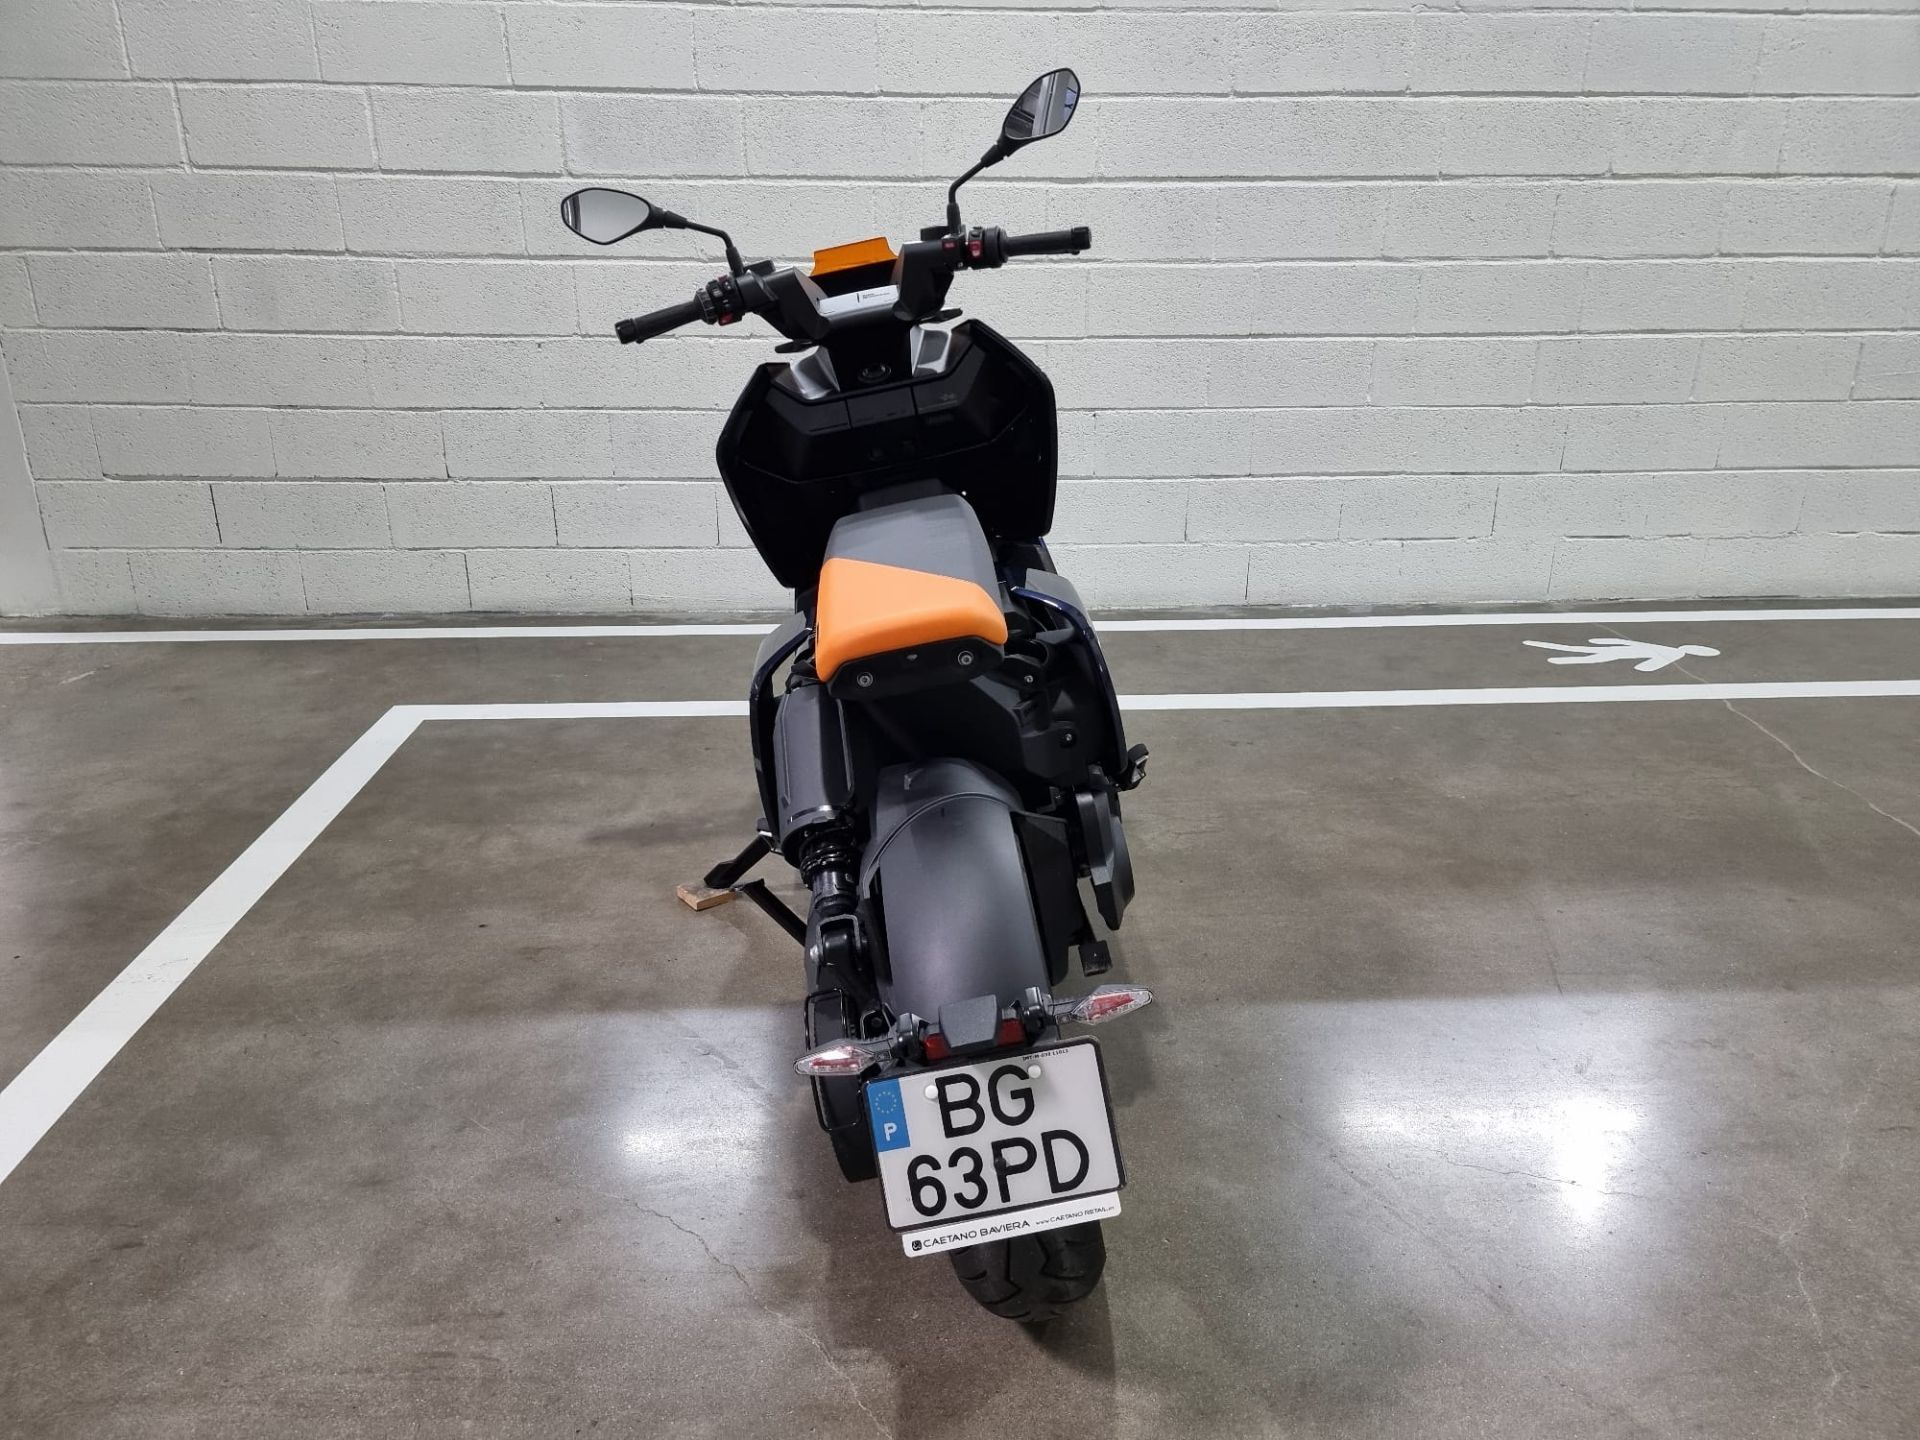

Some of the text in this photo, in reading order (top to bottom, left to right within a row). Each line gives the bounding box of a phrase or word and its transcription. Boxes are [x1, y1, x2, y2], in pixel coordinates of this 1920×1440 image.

[935, 1065, 1035, 1139] BG
[884, 1122, 898, 1142] P
[907, 1129, 1090, 1217] 63PD
[923, 1220, 1031, 1248] CAETANO BAVIERA
